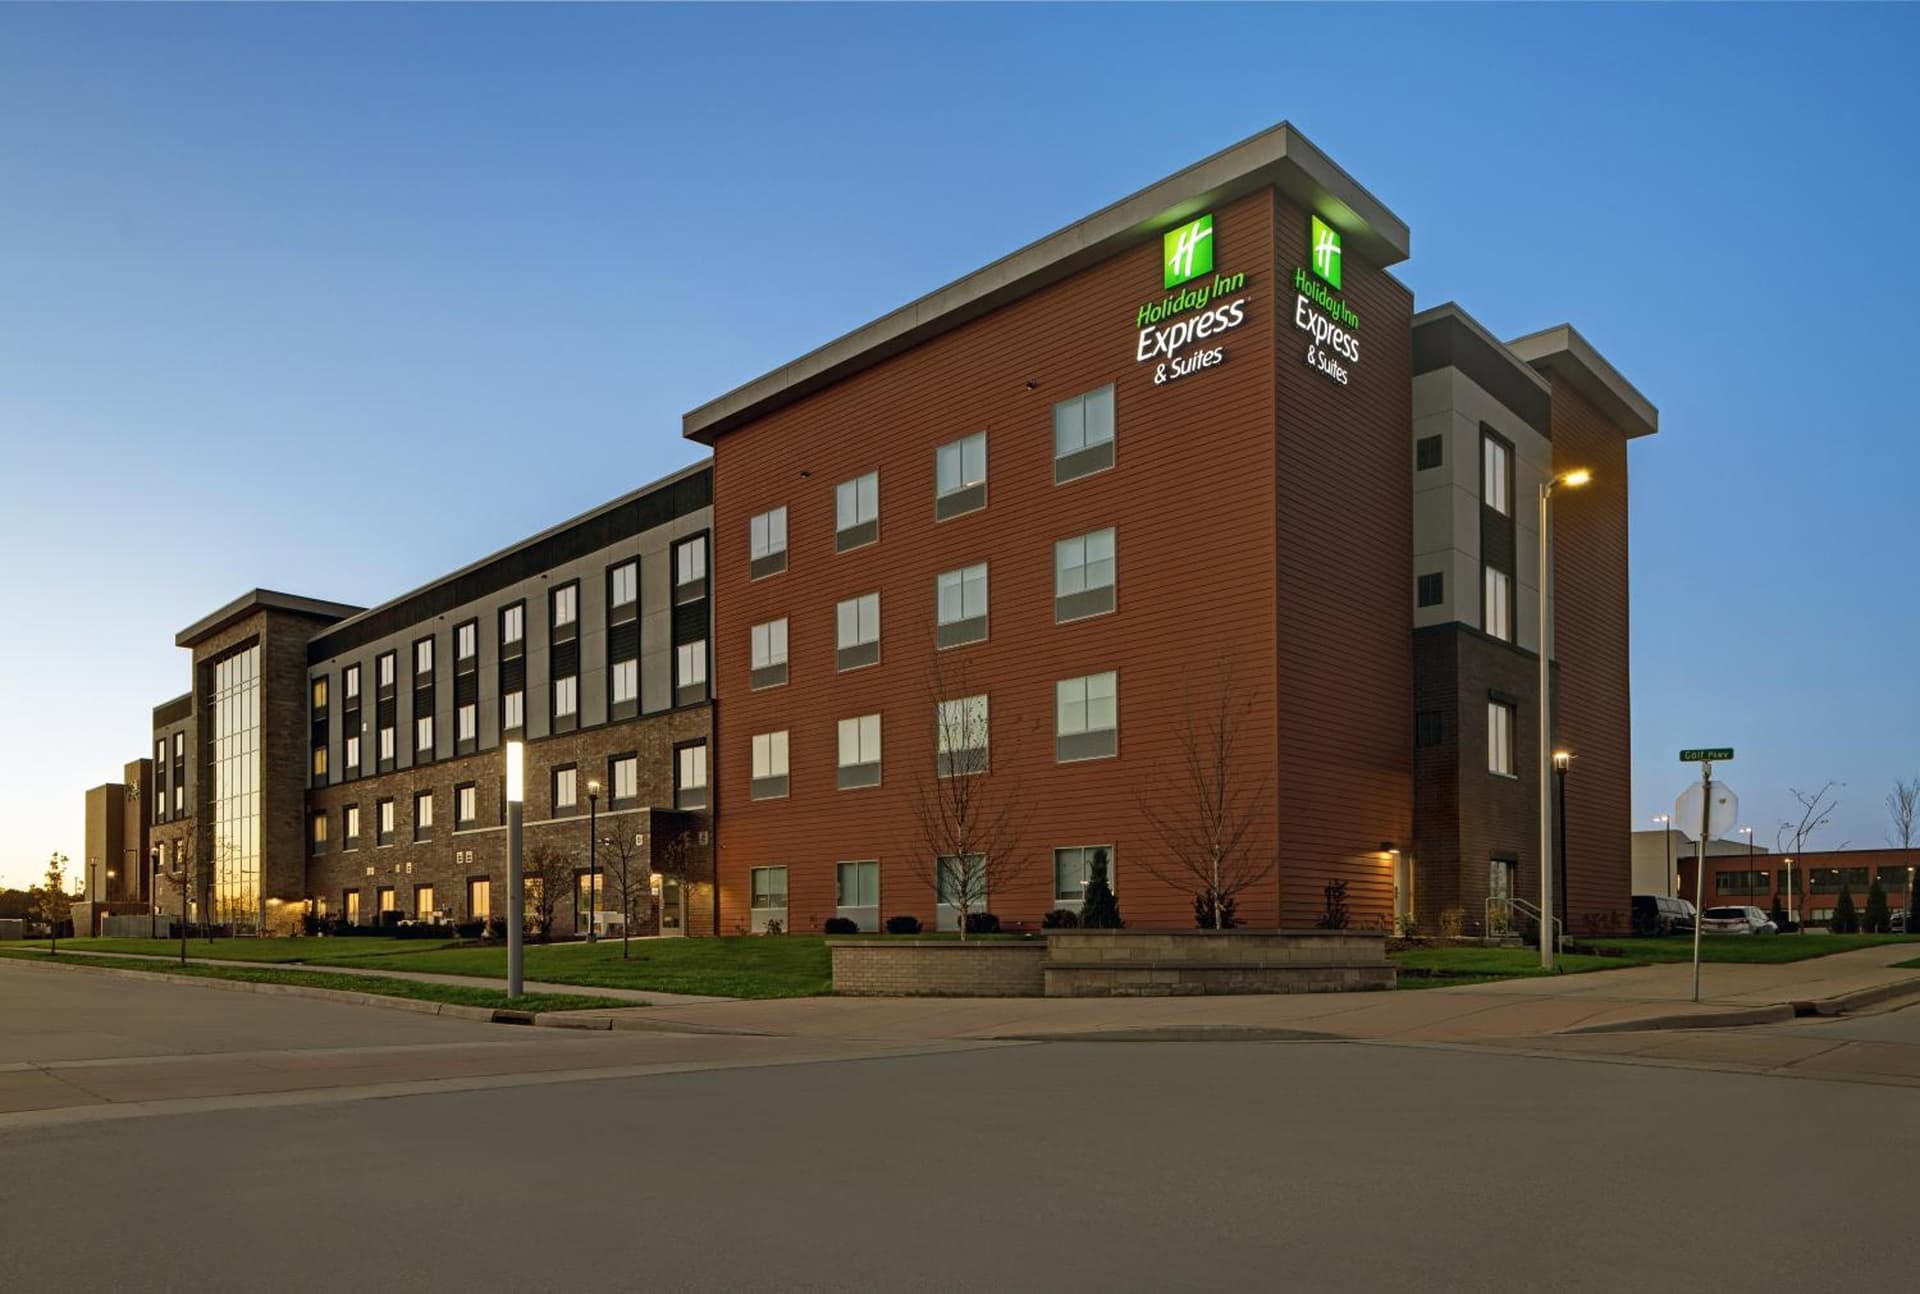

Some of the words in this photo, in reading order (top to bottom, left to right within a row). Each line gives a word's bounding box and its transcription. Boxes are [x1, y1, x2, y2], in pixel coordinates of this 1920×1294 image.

[1136, 285, 1210, 328] Holiday
[1212, 273, 1244, 298] Inn
[1295, 267, 1341, 320] Holiday
[1341, 299, 1359, 329] Inn
[1136, 298, 1245, 362] Express
[1295, 294, 1359, 362] Express
[1154, 363, 1167, 385] &
[1169, 346, 1223, 379] Suites
[1307, 344, 1316, 365] &
[1318, 350, 1348, 385] Suites
